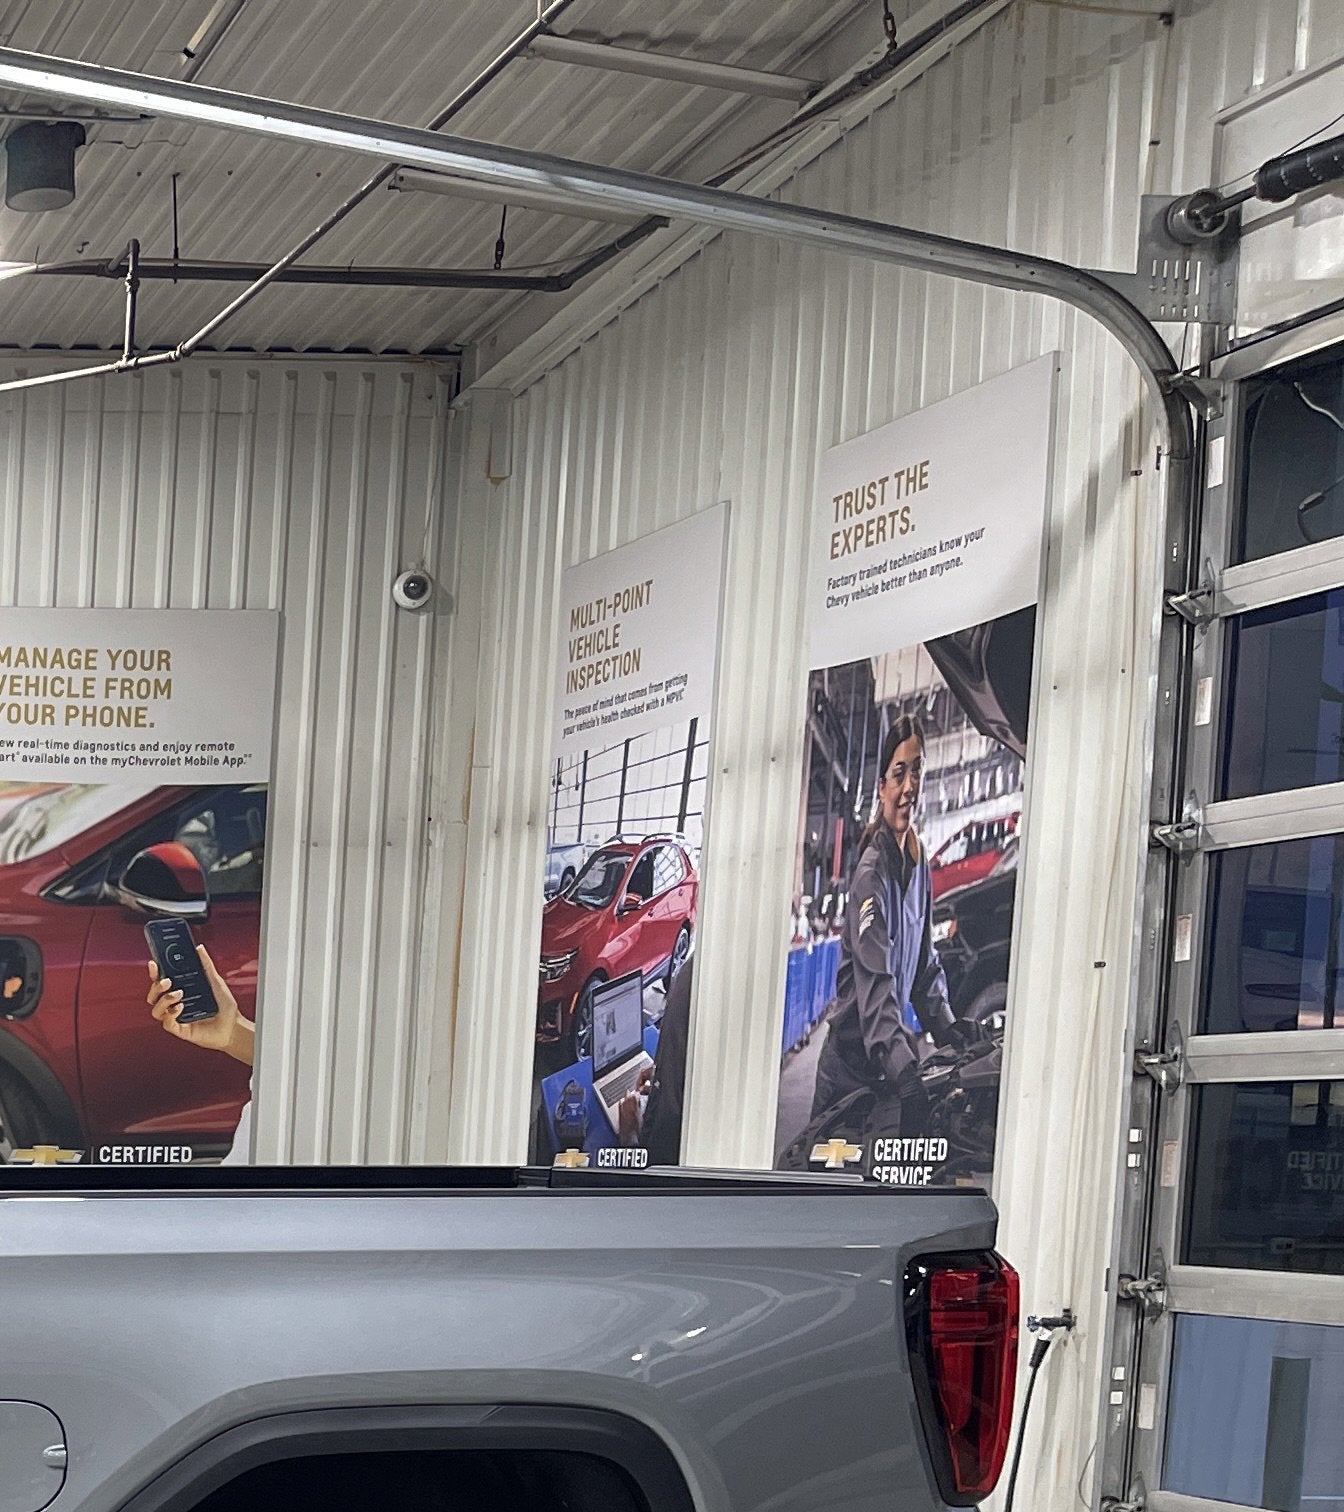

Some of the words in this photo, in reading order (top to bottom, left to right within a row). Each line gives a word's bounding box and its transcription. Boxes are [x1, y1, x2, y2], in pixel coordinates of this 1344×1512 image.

[833, 475, 889, 523] TRUST
[894, 460, 930, 500] THE
[830, 505, 916, 560] EXPERTS.
[827, 572, 857, 591] Factory
[859, 559, 888, 580] trained
[889, 544, 937, 570] technicians
[939, 536, 962, 553] know
[963, 527, 986, 548] your
[826, 592, 850, 608] Chevy
[851, 582, 879, 601] vehicle
[880, 573, 907, 593] better
[908, 566, 927, 583] than
[929, 555, 964, 577] anyone.
[570, 579, 653, 632] MULTI-POINT
[569, 623, 621, 663] VEHICLE
[107, 648, 172, 671] YOUR
[566, 647, 641, 694] INSPECTION
[104, 677, 172, 700] FROM
[64, 705, 155, 728] PHONE.
[17, 738, 70, 750] real-time
[73, 739, 136, 753] diagnostics
[139, 741, 160, 752] and
[162, 741, 192, 754] enjoy
[195, 741, 235, 752] remote
[21, 752, 70, 764] available
[73, 755, 87, 765] on
[90, 754, 108, 765] the
[111, 755, 182, 768] myChevrolet
[184, 756, 220, 766] Mobile
[99, 1145, 193, 1164] CERTIFIED
[597, 1147, 648, 1168] CERTIFIED
[874, 1137, 949, 1162] CERTIFIED
[872, 1166, 934, 1186] SERVICE
